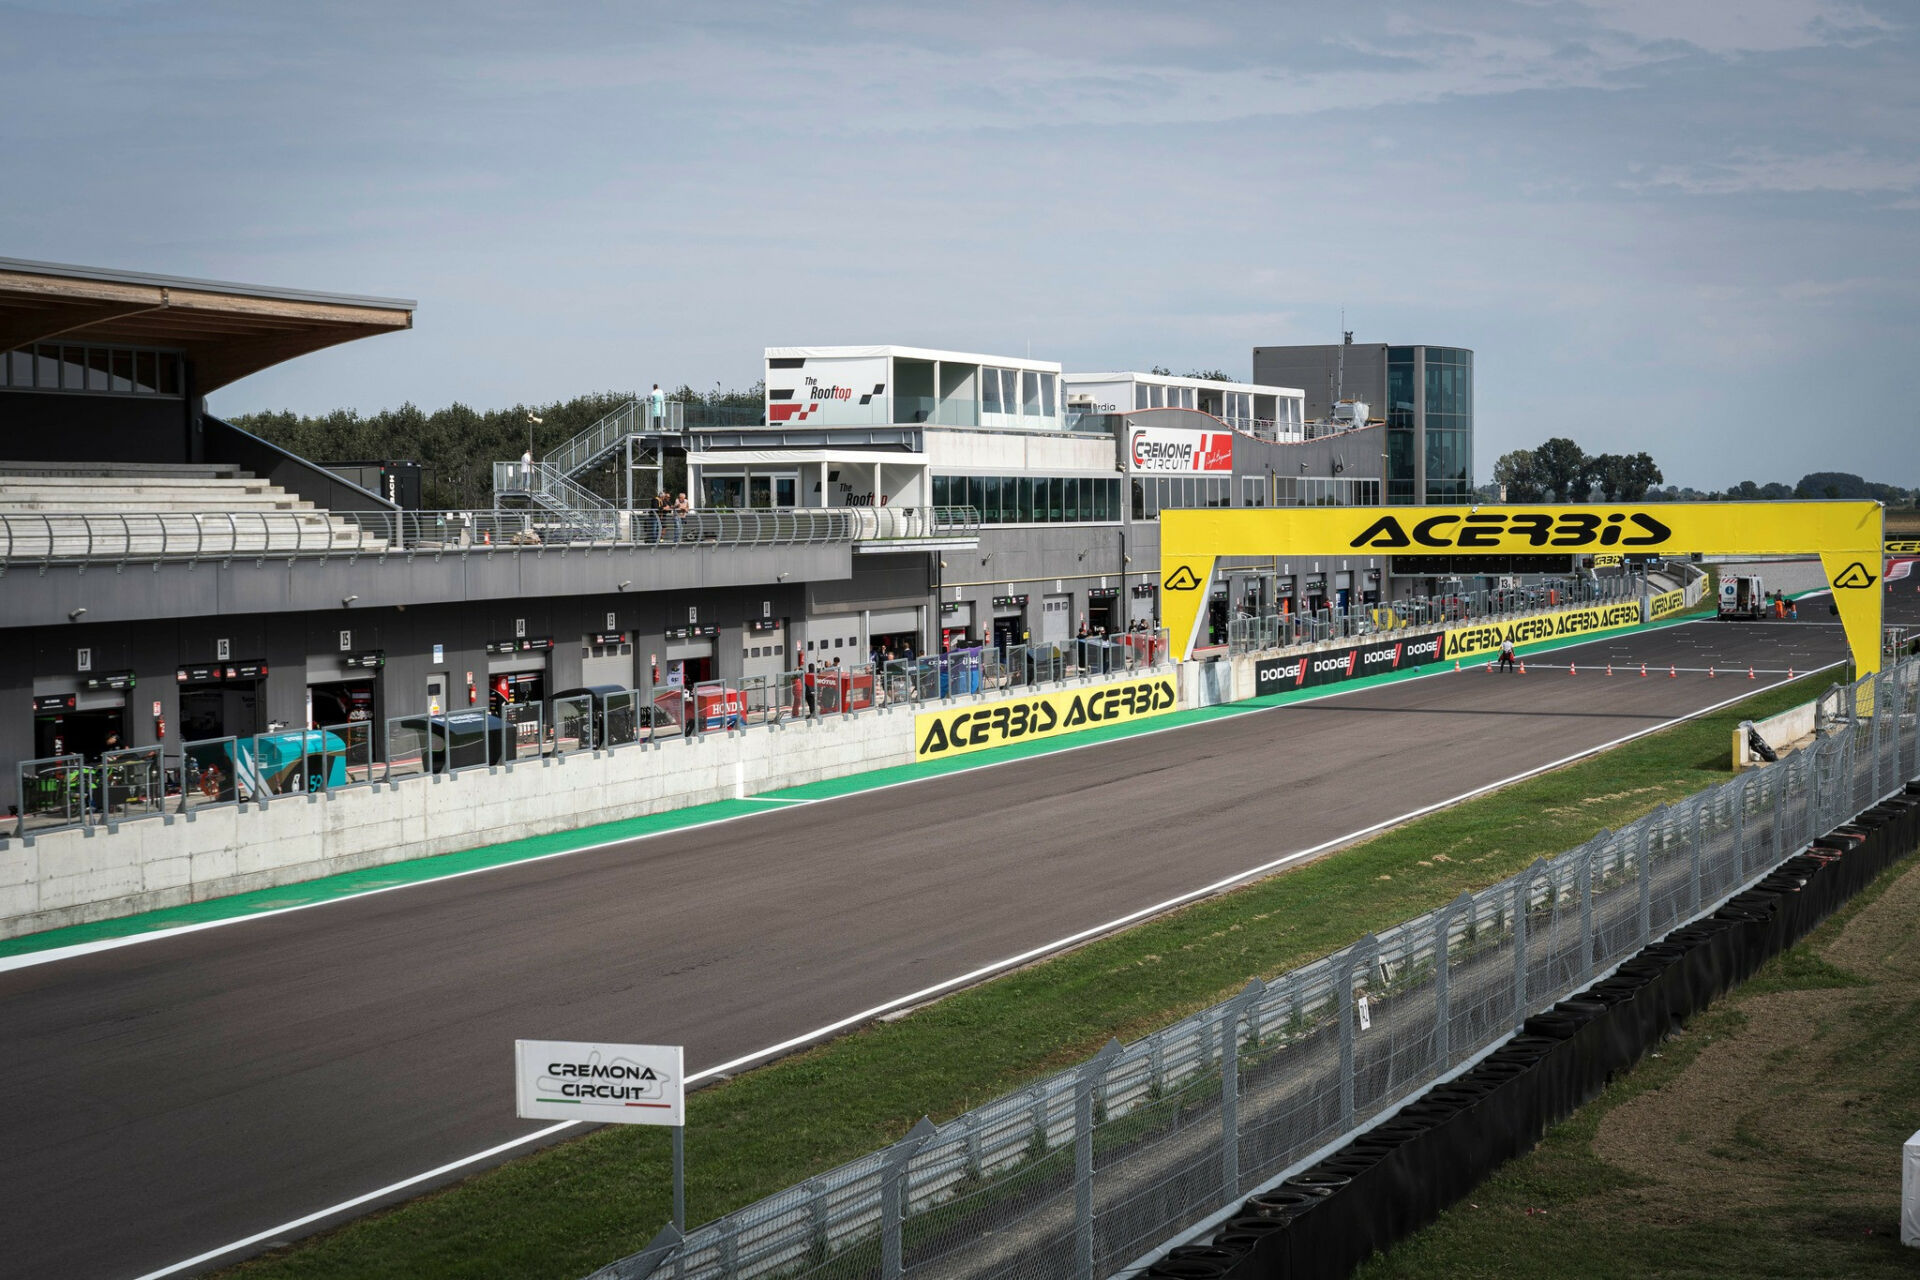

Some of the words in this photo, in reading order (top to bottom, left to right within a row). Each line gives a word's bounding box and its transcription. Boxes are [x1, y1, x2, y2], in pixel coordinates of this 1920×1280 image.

[804, 376, 818, 386] The
[810, 385, 852, 402] Rooftop
[1135, 441, 1192, 459] CREMONA
[1146, 459, 1191, 470] CIRCUIT
[840, 483, 853, 492] The
[845, 492, 888, 507] Rooftp
[219, 641, 228, 656] 16
[80, 650, 89, 666] 17
[1260, 663, 1301, 682] DODGE
[1314, 656, 1351, 673] DODGE
[1364, 648, 1397, 665] DODGE
[1407, 640, 1438, 656] DODGE
[712, 701, 744, 715] HONDA
[548, 1063, 658, 1081] CREMONA
[561, 1084, 645, 1100] CIRCUIT
